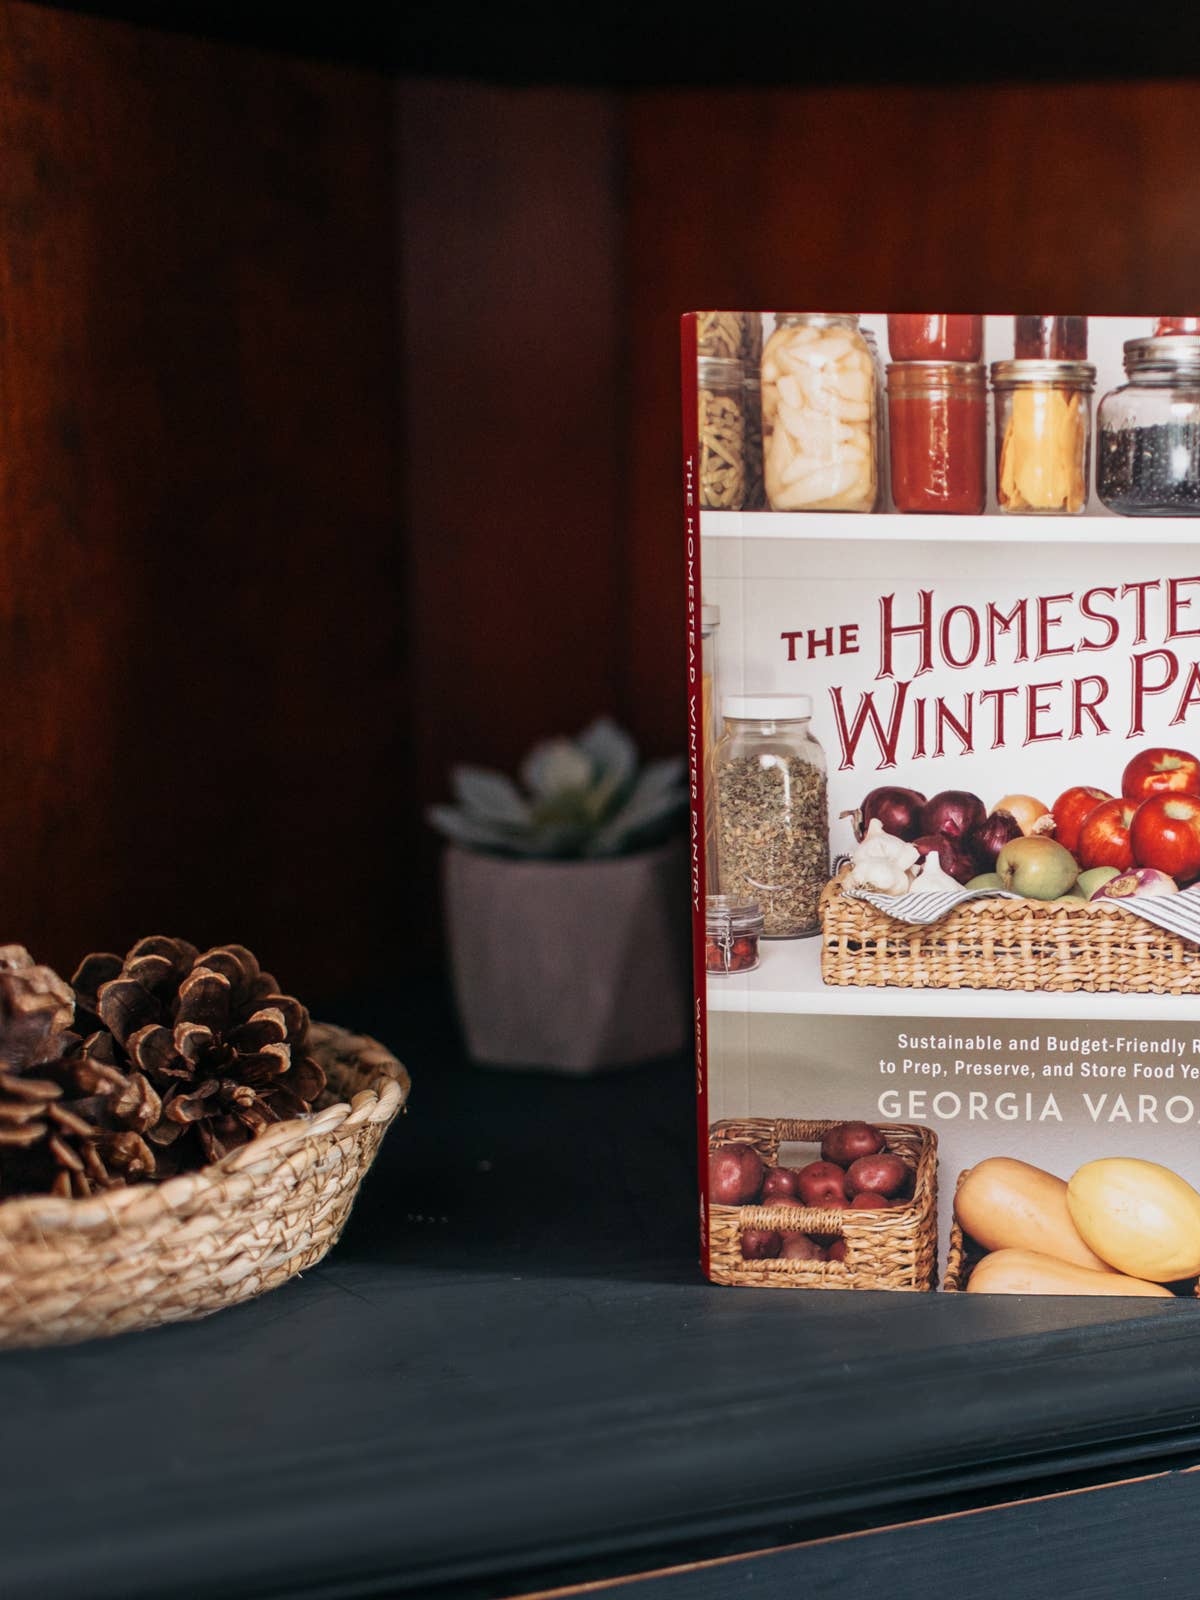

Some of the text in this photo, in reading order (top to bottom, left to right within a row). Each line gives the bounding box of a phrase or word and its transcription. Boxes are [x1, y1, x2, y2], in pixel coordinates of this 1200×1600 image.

[687, 517, 696, 684] HOMESTEAD
[781, 623, 860, 663] THE
[689, 695, 698, 799] WINTER
[828, 673, 1112, 771] WINTER
[692, 810, 700, 912] PANTRY
[879, 1058, 897, 1075] to
[902, 1059, 949, 1078] Prep,
[954, 1060, 1036, 1080] Preserve,
[1042, 1062, 1074, 1078] and
[1080, 1062, 1128, 1080] Store
[1133, 1063, 1176, 1081] Food
[897, 1033, 1003, 1051] Sustainable
[1008, 1036, 1041, 1052] and
[1047, 1036, 1187, 1057] Budget-Friendly
[877, 1090, 1065, 1123] GEORGIA
